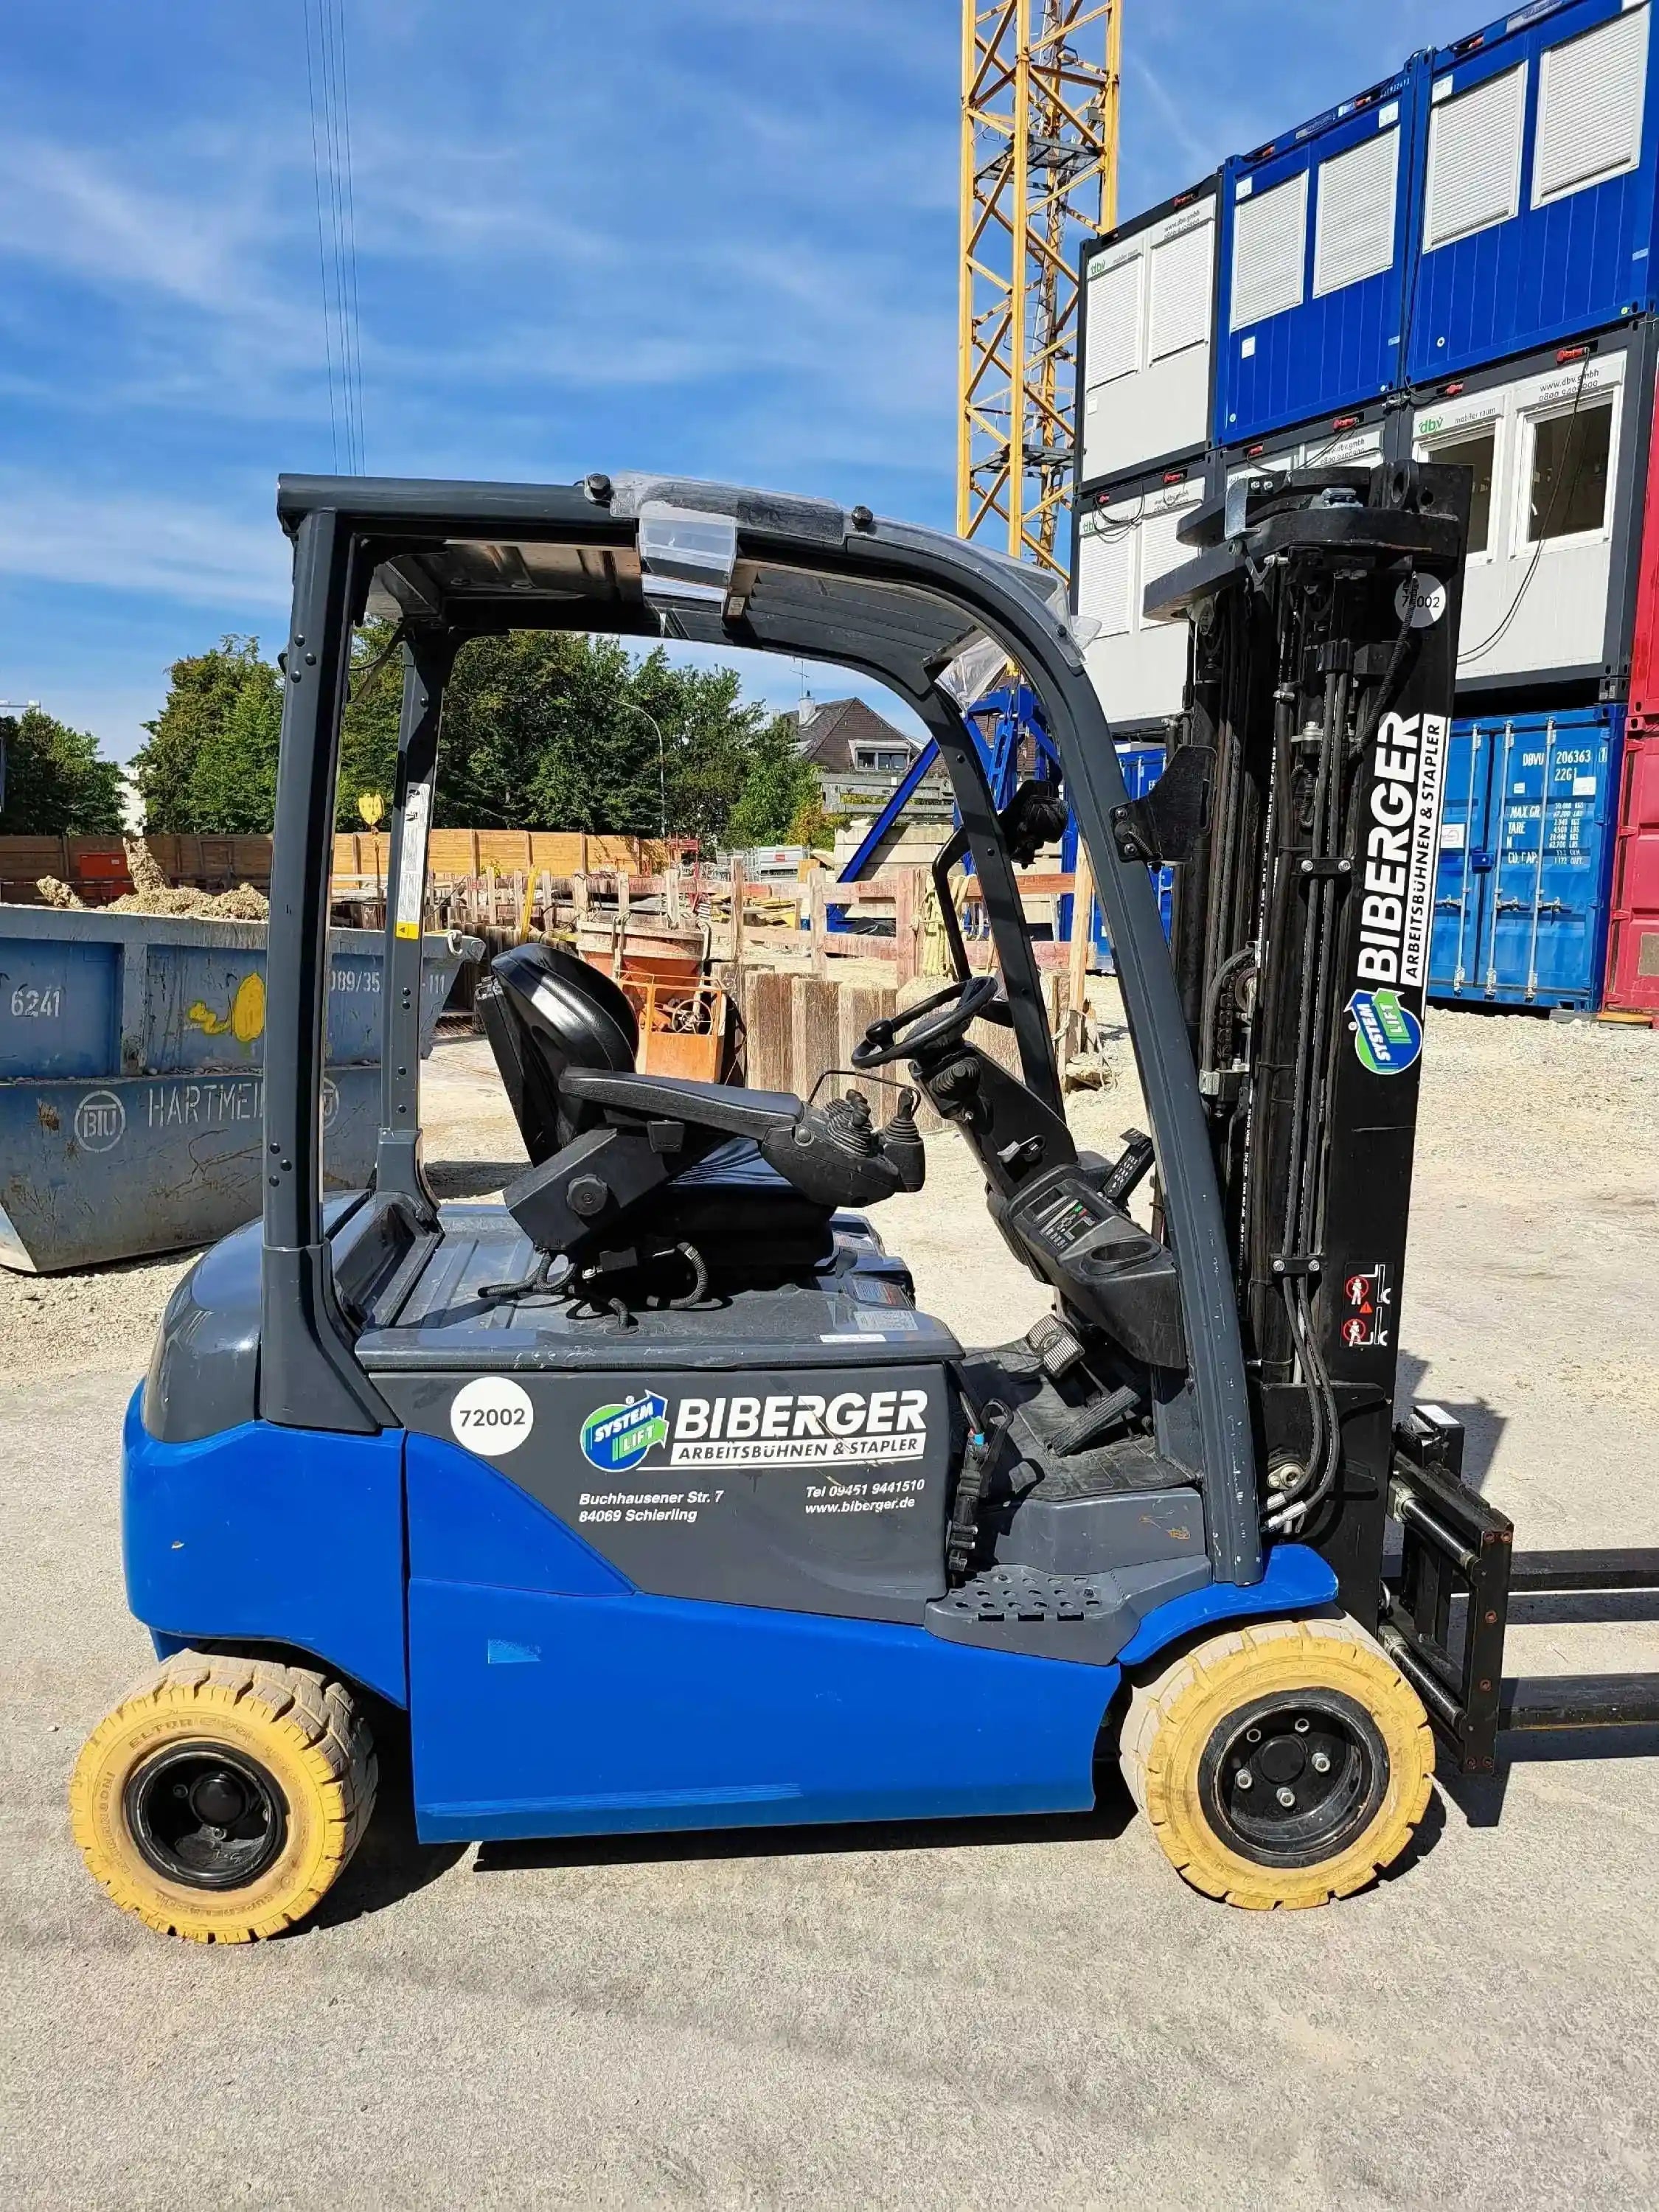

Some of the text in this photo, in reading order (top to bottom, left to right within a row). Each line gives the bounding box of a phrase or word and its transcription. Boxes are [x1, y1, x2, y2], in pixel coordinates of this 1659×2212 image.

[1419, 416, 1443, 434] dbv
[1402, 595, 1440, 608] 7002
[1424, 723, 1441, 802] STAPLER
[1523, 753, 1545, 766] DBVU
[1557, 750, 1591, 764] 206363
[1554, 768, 1577, 781] 22G1
[1422, 807, 1433, 820] &
[1508, 821, 1526, 834] TARE
[1357, 712, 1420, 984] BIBERGER
[10, 987, 61, 1018] 6241
[1380, 1003, 1404, 1033] LIFT
[1357, 1004, 1391, 1061] SYSTEM
[459, 1408, 526, 1427] 72002
[593, 1399, 655, 1443] SYSTEM
[674, 1390, 928, 1439] BIBERGER
[622, 1423, 656, 1453] LIFT
[678, 1437, 919, 1461] ARBEITSBÜHNEN & STAPLER
[579, 1489, 724, 1506] Buchhausener Str. 7
[806, 1478, 925, 1499] Tel 09451 9441510
[578, 1508, 698, 1524] 84069 Schierling
[804, 1497, 916, 1516] www.biberger.de
